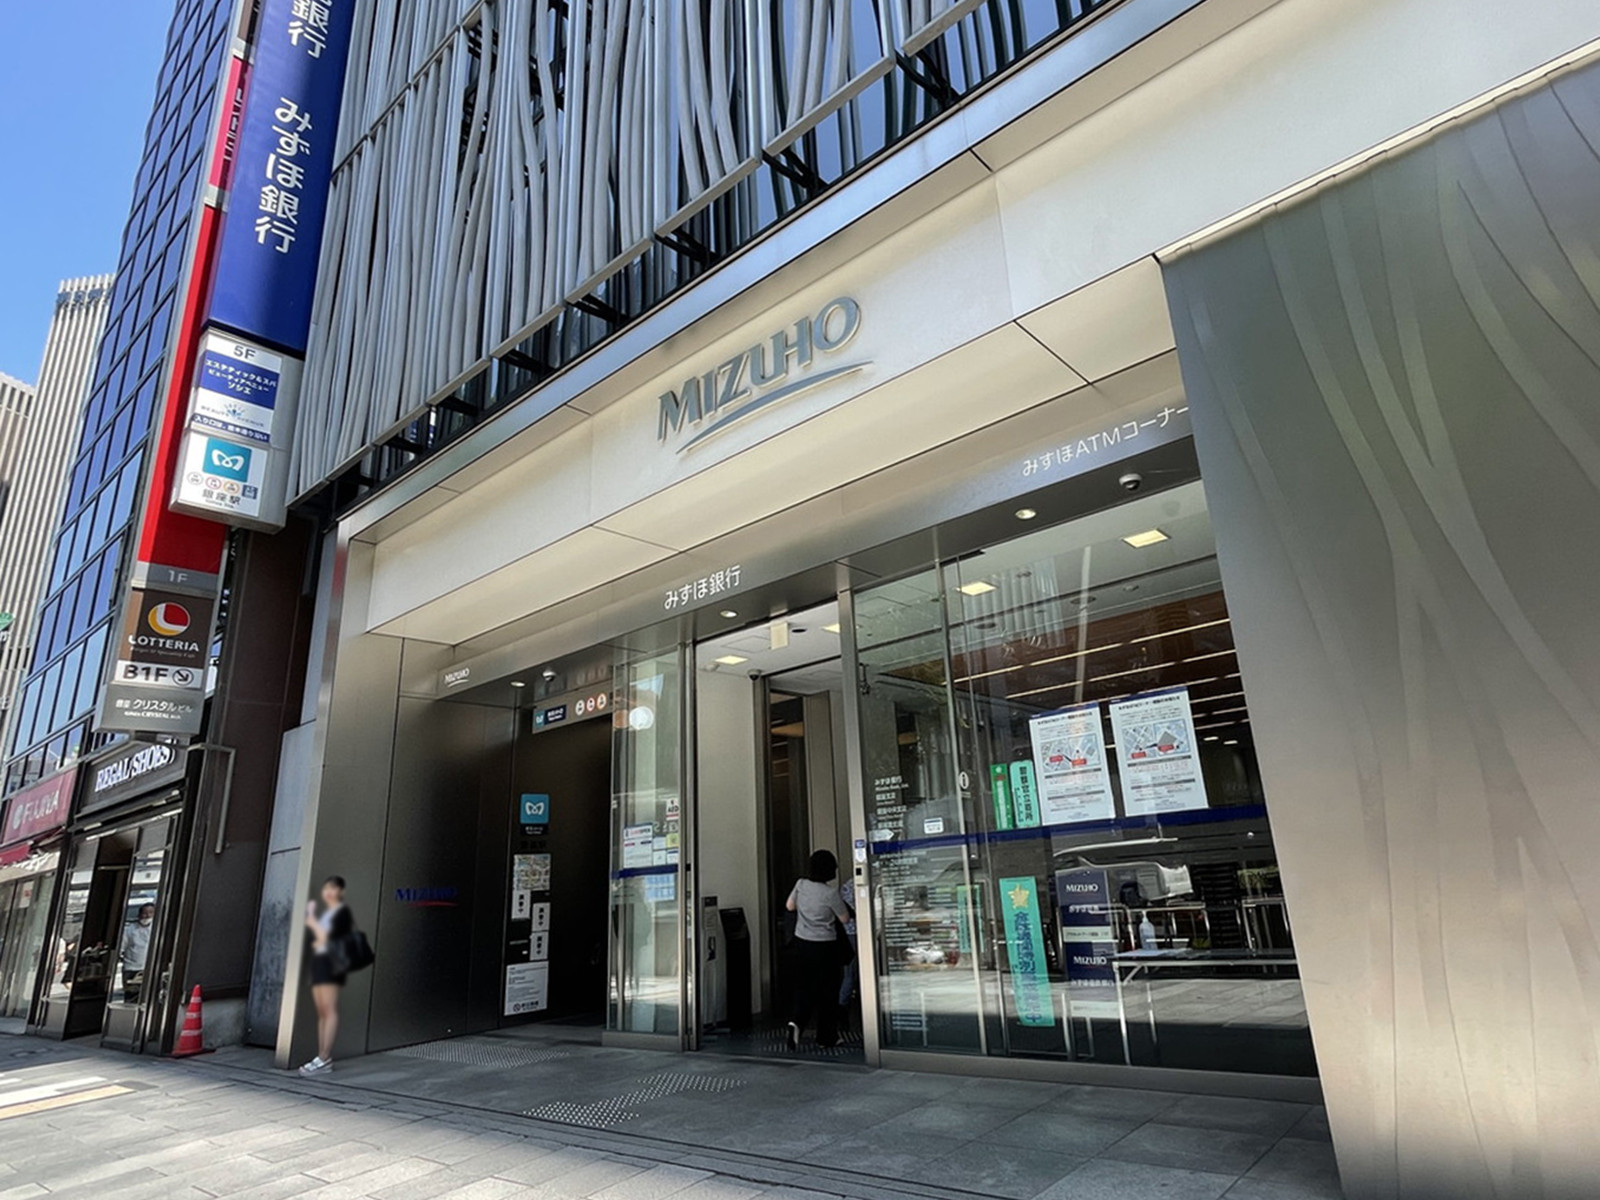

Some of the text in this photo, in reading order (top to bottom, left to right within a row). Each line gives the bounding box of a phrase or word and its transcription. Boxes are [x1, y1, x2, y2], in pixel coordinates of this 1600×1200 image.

[288, 0, 333, 58] 銀行
[254, 97, 313, 254] みずほ銀行
[233, 345, 256, 360] 5F
[657, 295, 862, 442] MIZUHO
[228, 382, 252, 395] ソシエ
[168, 569, 189, 583] 1F
[664, 564, 742, 611] みずほ銀行
[128, 635, 200, 652] LOTTERIA
[123, 664, 169, 682] B1F
[94, 744, 172, 792] REGAL SHOES
[1065, 883, 1099, 893] MIZUHO
[1073, 956, 1107, 965] MIZUHO
